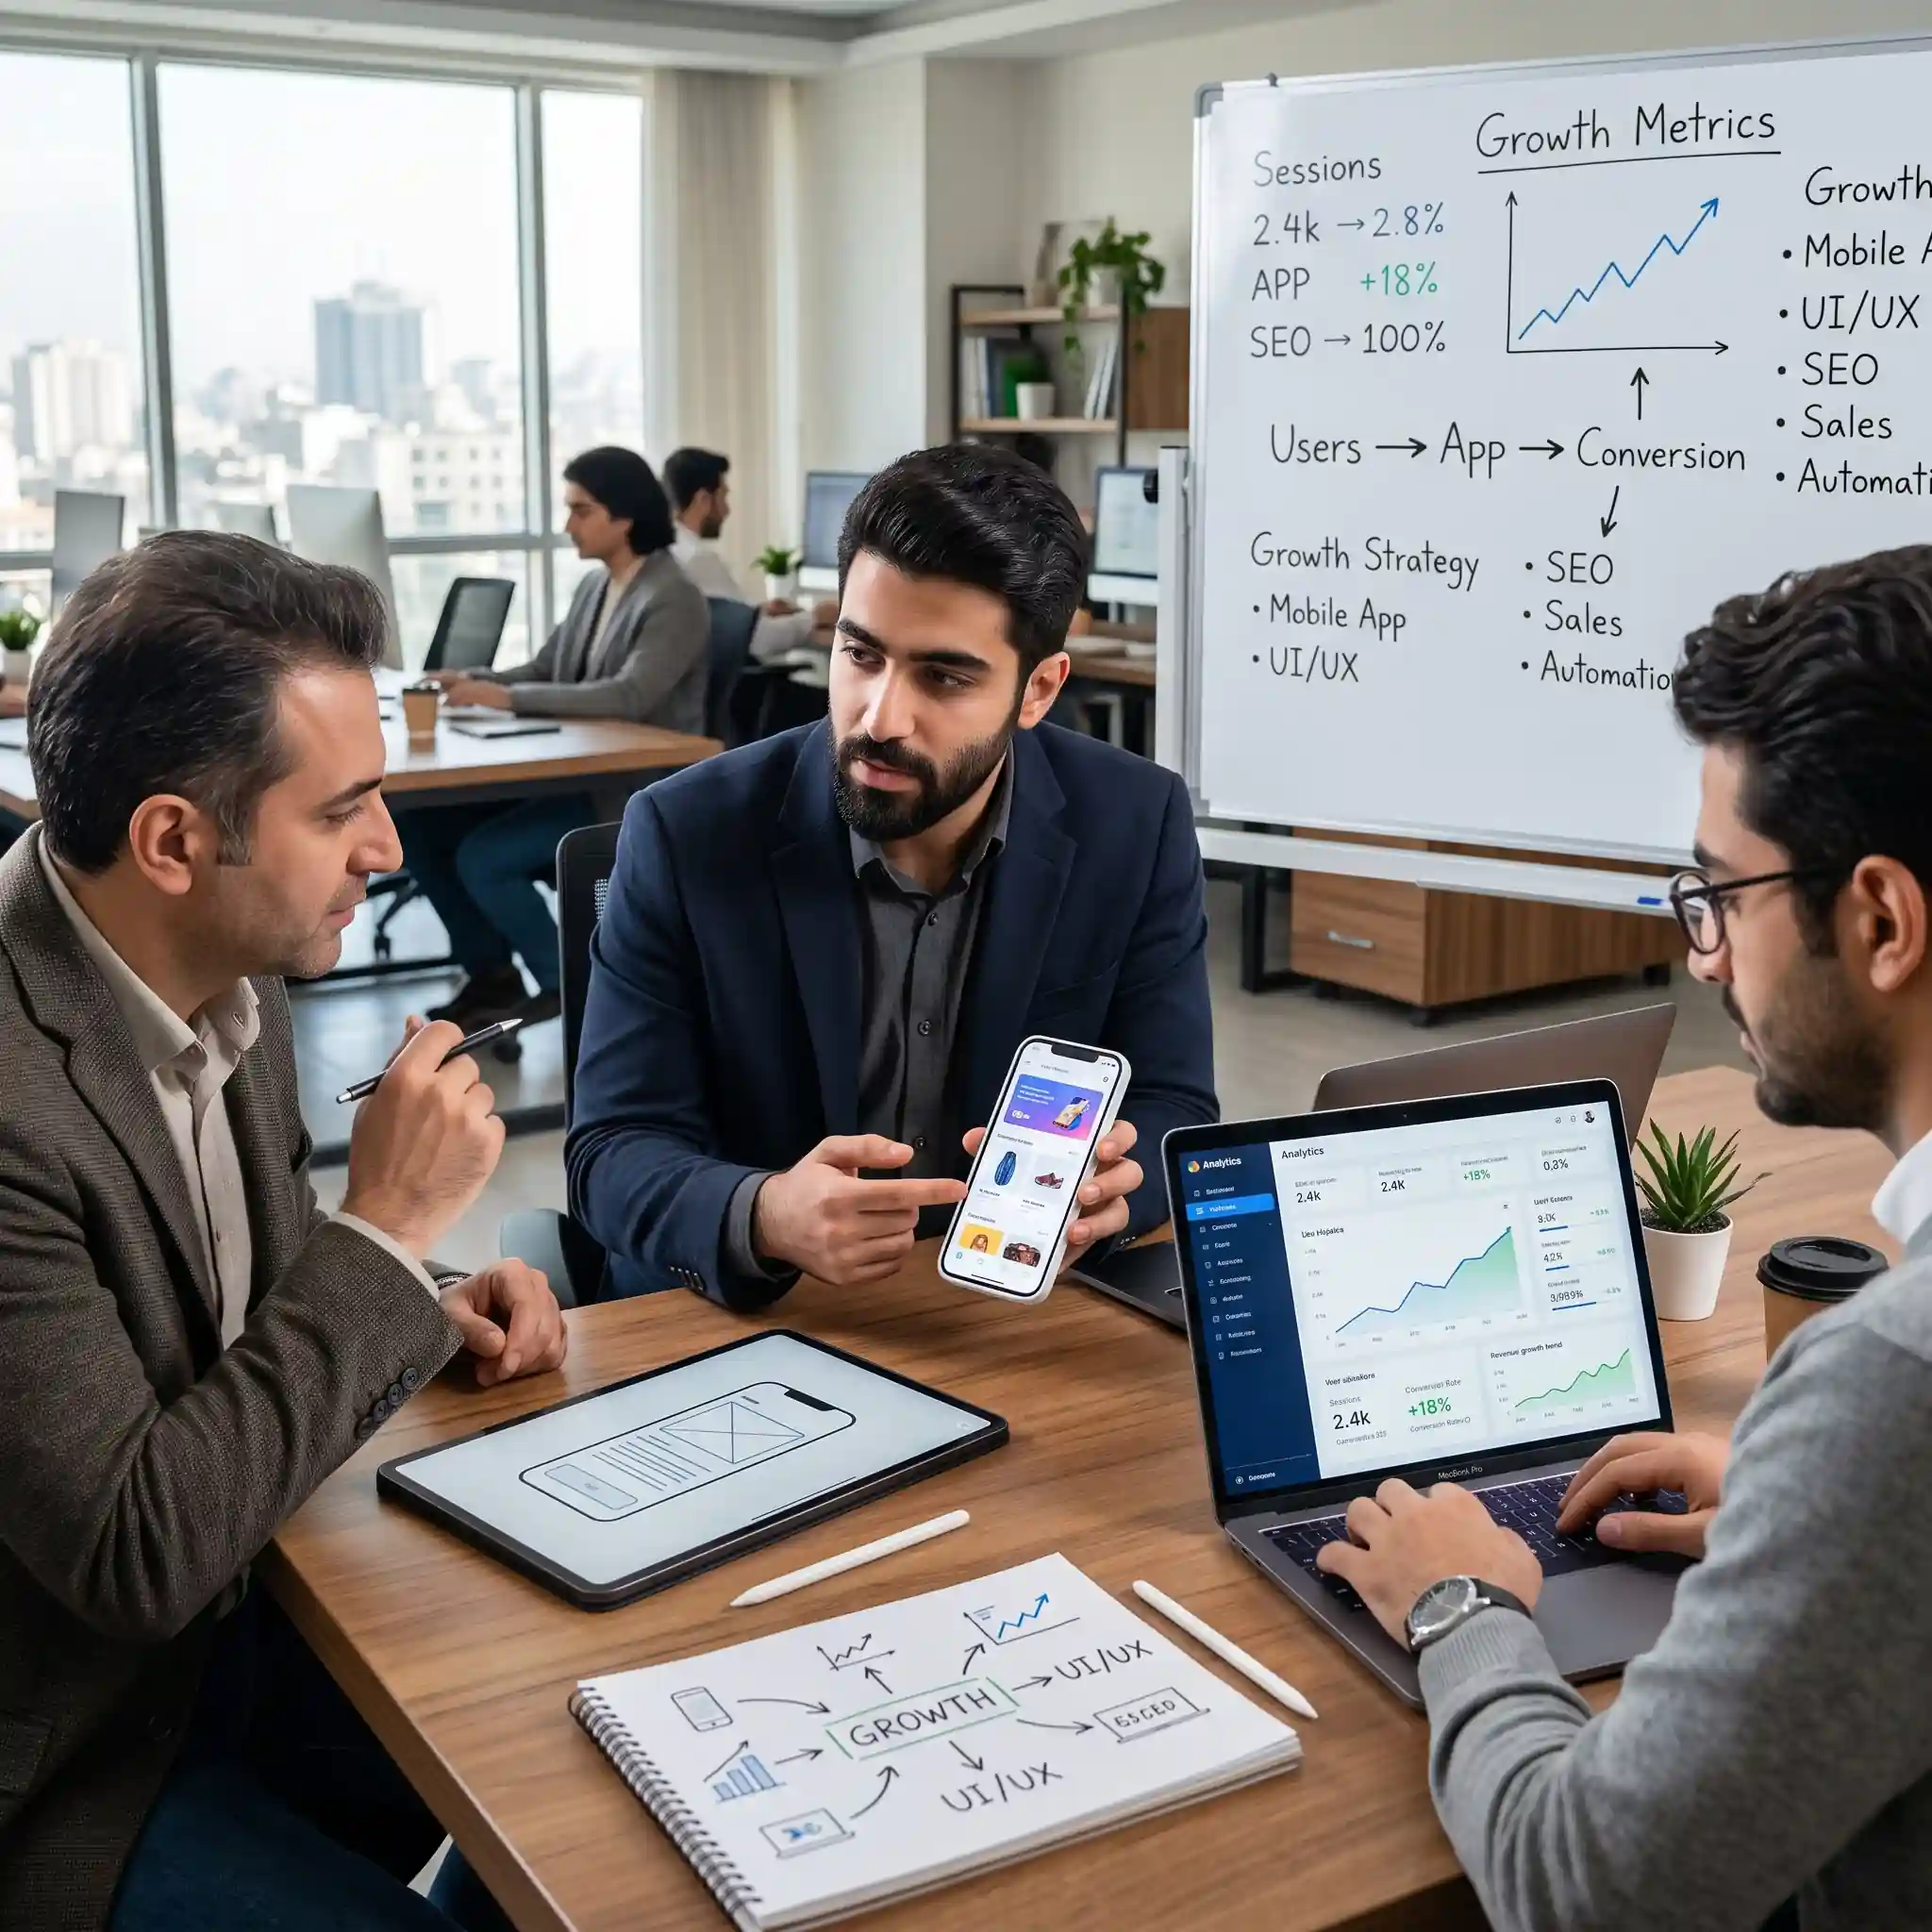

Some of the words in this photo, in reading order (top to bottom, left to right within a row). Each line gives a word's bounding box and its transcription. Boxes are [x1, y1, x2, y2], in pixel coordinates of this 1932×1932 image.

[1476, 108, 1609, 158] Growth
[1636, 102, 1774, 146] Metrics
[1253, 151, 1382, 186] Sessions
[1806, 164, 1932, 206] Growth
[1254, 209, 1320, 245] 2.4k
[1373, 202, 1443, 237] 2.8%
[1806, 230, 1905, 267] Mobile
[1252, 268, 1310, 301] APP
[1361, 261, 1438, 295] +18%
[1803, 290, 1920, 334] UI/UX
[1251, 325, 1310, 358] SEO
[1363, 321, 1445, 353] 100%
[1802, 352, 1878, 385] SEO
[1801, 404, 1891, 439] Sales
[1272, 425, 1361, 464] Users
[1440, 422, 1505, 479] App
[1577, 426, 1744, 470] Conversion
[1251, 531, 1349, 569] Growth
[1365, 537, 1479, 591] Strategy
[1547, 551, 1613, 585] SEO
[1271, 593, 1347, 627] Mobile
[1359, 598, 1406, 642] App
[1545, 600, 1623, 637] Sales
[1271, 645, 1358, 683] UI/UX
[1541, 650, 1674, 691] Automatio
[1203, 1158, 1241, 1169] Analytics
[1281, 1147, 1324, 1159] Analytics
[1296, 1191, 1322, 1203] 2.4k
[1521, 1345, 1544, 1355] growth
[1329, 1396, 1361, 1407] Sessions
[1333, 1410, 1371, 1430] 2.4k
[1408, 1397, 1452, 1416] +18%
[1055, 1641, 1153, 1679] UI/UX
[849, 1689, 997, 1747] GROWTH
[941, 1762, 1062, 1812] UI/UX
